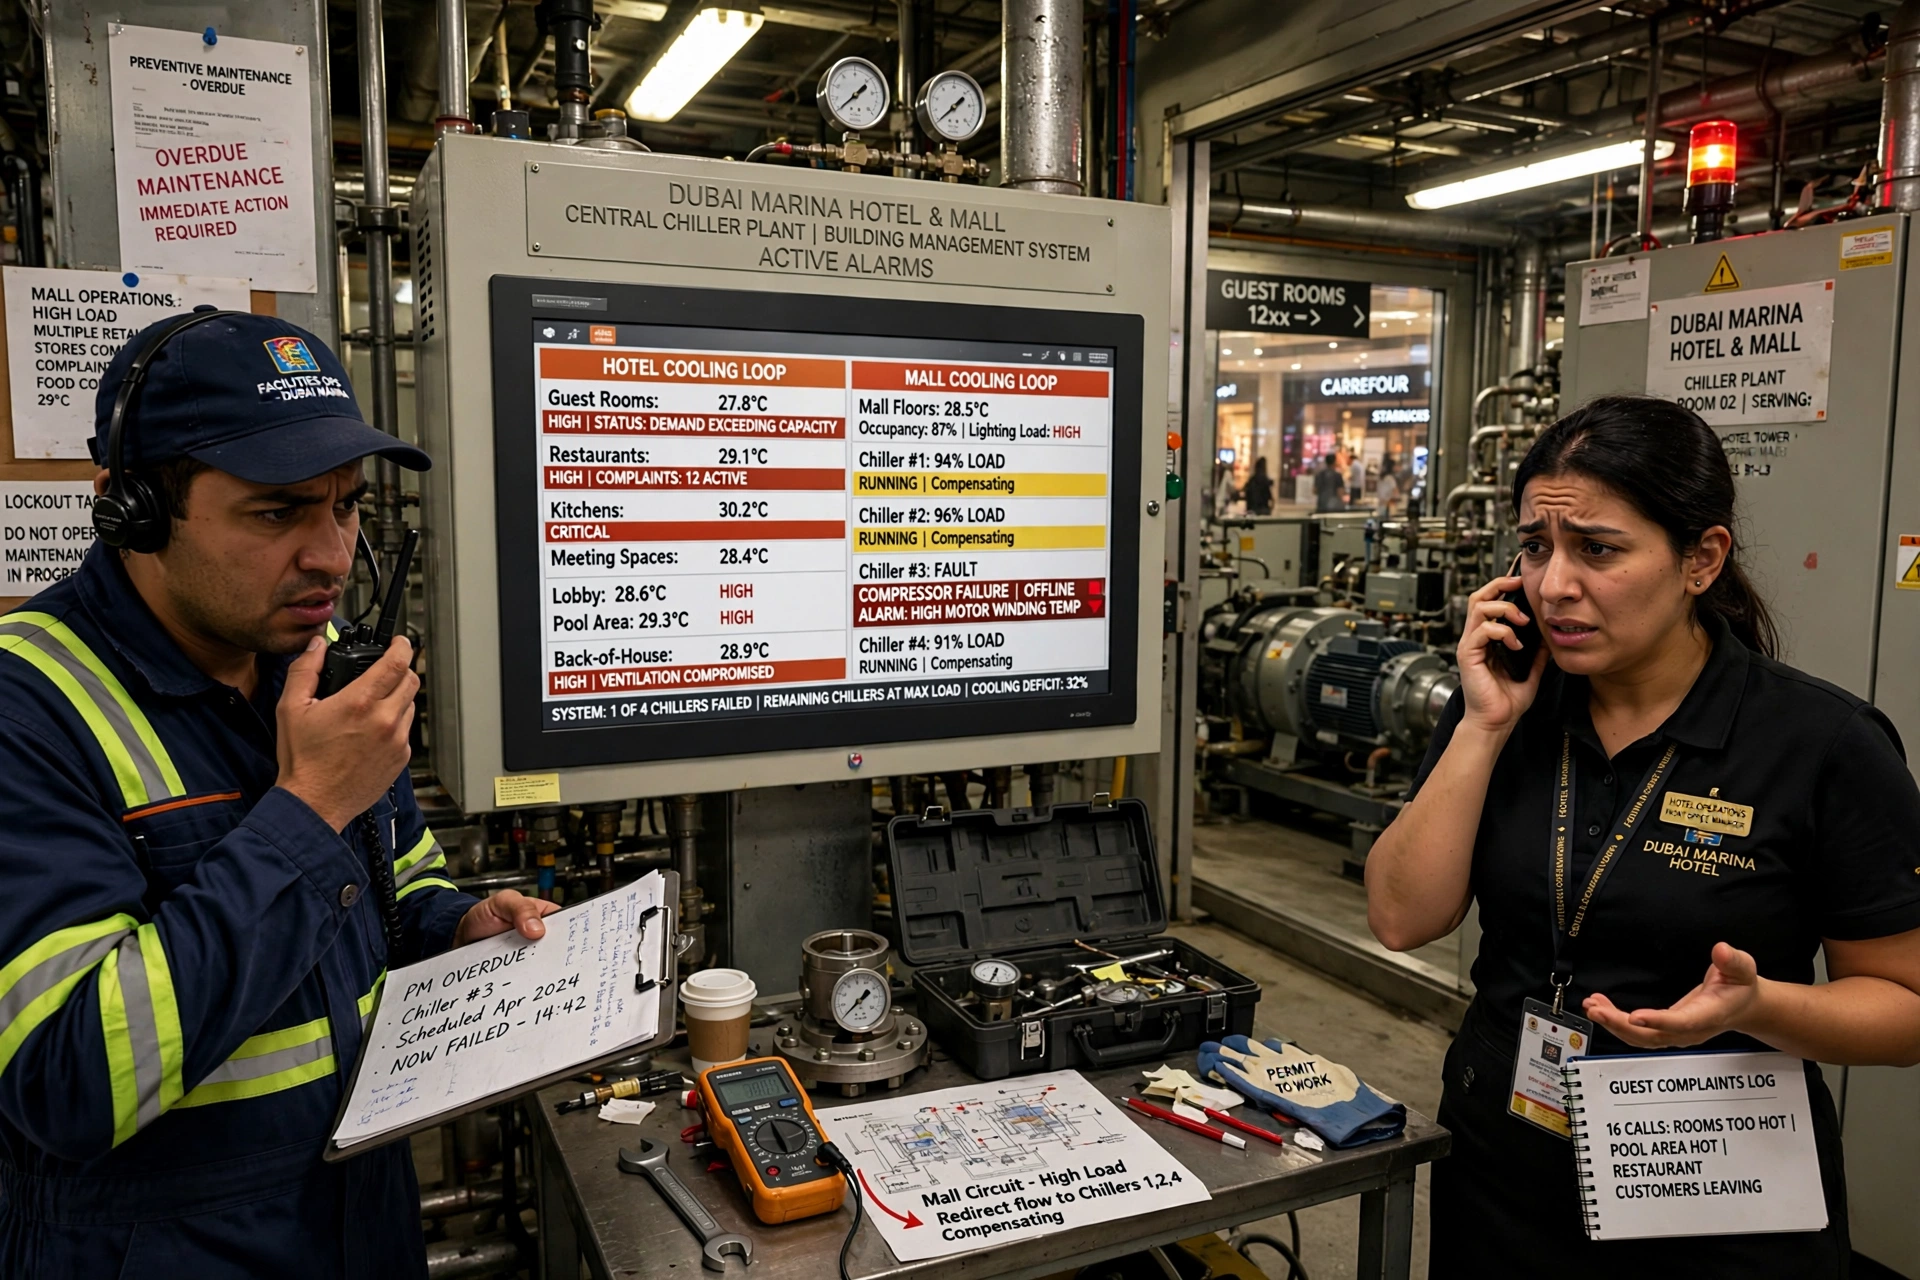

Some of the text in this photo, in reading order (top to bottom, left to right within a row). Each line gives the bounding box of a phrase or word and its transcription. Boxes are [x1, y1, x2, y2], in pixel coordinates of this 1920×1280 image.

[130, 56, 292, 84] PREVENTIVE MAINTENANCE
[190, 79, 245, 95] OVERDUE
[156, 143, 248, 166] OVERDUE
[138, 167, 284, 196] MAINTENANCE
[140, 196, 288, 221] IMMEDIATE ACTION
[670, 183, 1006, 232] DUBAI MARINA HOTEL & MALL
[155, 221, 236, 242] REQUIRED
[566, 205, 1089, 262] CENTRAL CHILLER PLANT BUILDING MANAGEMENT SYSTEM
[759, 247, 933, 278] ACTIVE ALARMS
[32, 287, 74, 302] MALL
[1221, 279, 1345, 305] GUEST ROOMS
[33, 306, 117, 322] HIGH LOAD
[1671, 302, 1803, 334] DUBAI MARINA
[34, 324, 98, 338] MULTIPLE
[35, 342, 86, 355] STORES
[1671, 332, 1800, 361] HOTEL & MALL
[604, 358, 786, 380] HOTEL COOLING LOOP
[37, 377, 75, 389] FOOD
[257, 376, 321, 394] FACILITIES
[906, 370, 1057, 390] MALL COOLING LOOP
[1321, 375, 1408, 396] CARREFOUR
[1685, 370, 1786, 390] CHILLER PLANT
[38, 394, 70, 406] 29°C
[548, 389, 767, 411] Guest Rooms: 27.8°C
[860, 398, 988, 417] Mall Floors: 28.5°C
[1720, 395, 1736, 410] 02
[1752, 392, 1812, 408] SERVING:
[549, 414, 837, 434] HIGH STATUS: DEMAND EXCEEDING CAPACITY
[859, 420, 1080, 441] Occupancy: 87% Lighting Load: HIGH
[550, 446, 767, 464] Restaurants: 29.1°C
[860, 451, 1005, 468] Chiller #1: 94% LOAD
[550, 470, 747, 485] HIGH COMPLAINTS: 12 ACTIVE
[6, 494, 72, 509] LOCKOUT
[551, 501, 768, 518] Kitchens: 30.2°C
[5, 526, 25, 540] DO
[30, 526, 58, 540] NOT
[551, 525, 610, 538] CRITICAL
[8, 568, 21, 582] IN
[860, 562, 978, 579] Chiller #3: FAULT
[859, 582, 1075, 602] COMPRESSOR FAILURE OFFLINE
[859, 600, 1081, 622] ALARM: HIGH MOTOR WINDING TEMP
[1644, 840, 1755, 870] DUBAI MARINA
[1670, 858, 1719, 876] HOTEL
[404, 946, 536, 1001] PM OVERDUE:
[396, 973, 579, 1048] Scheduled Apr 2024
[402, 982, 493, 1024] Chiller #3
[390, 996, 586, 1075] NOW FAILED 14:42
[1266, 1062, 1315, 1080] PERMIT
[1275, 1082, 1292, 1093] TO
[1293, 1074, 1332, 1091] WORK
[1610, 1074, 1775, 1094] GUEST COMPLAINTS LOG
[1607, 1115, 1786, 1136] 16 CALLS: ROOMS TOO HOT
[1610, 1140, 1717, 1157] POOL AREA HOT
[1613, 1161, 1702, 1178] RESTAURANT
[922, 1159, 1127, 1207] Mall Circuit High Load
[1616, 1179, 1762, 1199] CUSTOMERS LEAVING
[937, 1172, 1182, 1225] Redirect flow to Chillers 1,2,4
[942, 1210, 1064, 1241] Compensating
